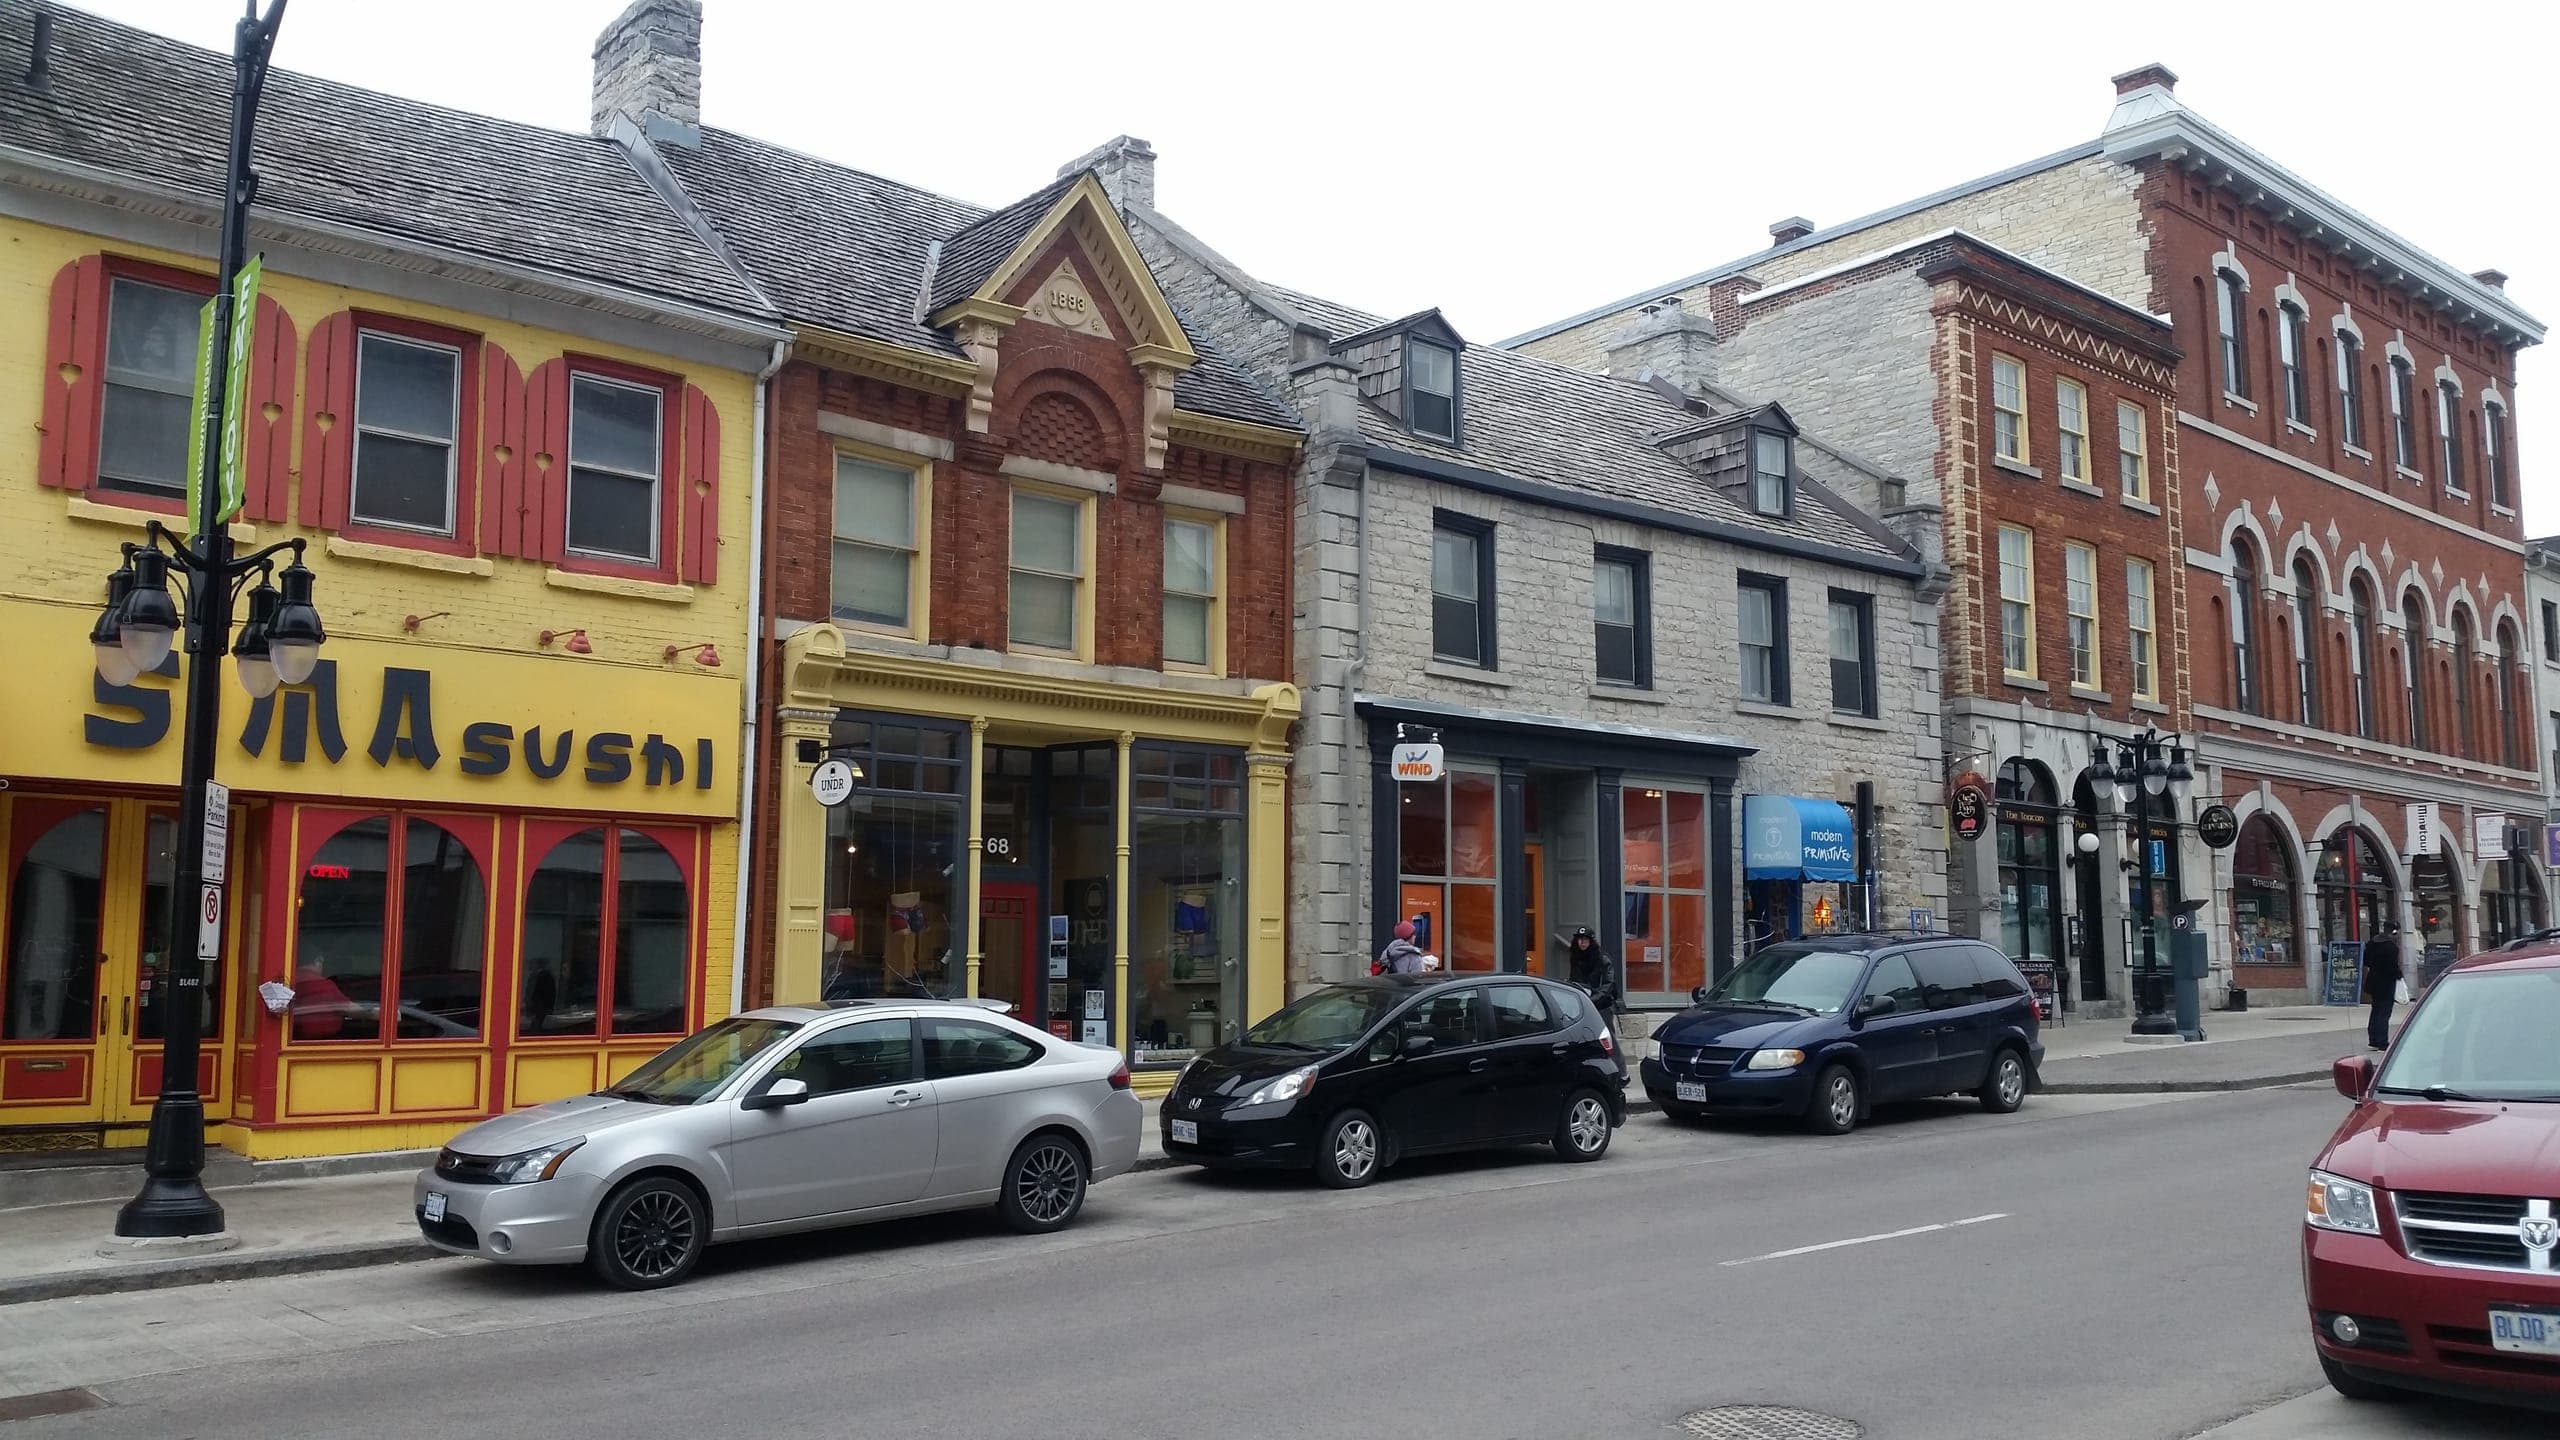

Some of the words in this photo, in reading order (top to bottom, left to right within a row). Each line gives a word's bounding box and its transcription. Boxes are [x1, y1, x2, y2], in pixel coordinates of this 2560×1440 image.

[1051, 289, 1085, 313] 1893
[226, 273, 251, 511] ENJOY
[84, 650, 441, 771] SMA
[1397, 763, 1433, 776] WIND
[821, 778, 844, 791] UNDR
[2006, 810, 2018, 819] The
[2075, 820, 2087, 829] Pub
[1811, 829, 1843, 843] modern
[2418, 805, 2427, 852] Minotaur
[987, 838, 1009, 854] 68
[309, 864, 350, 879] OPEN
